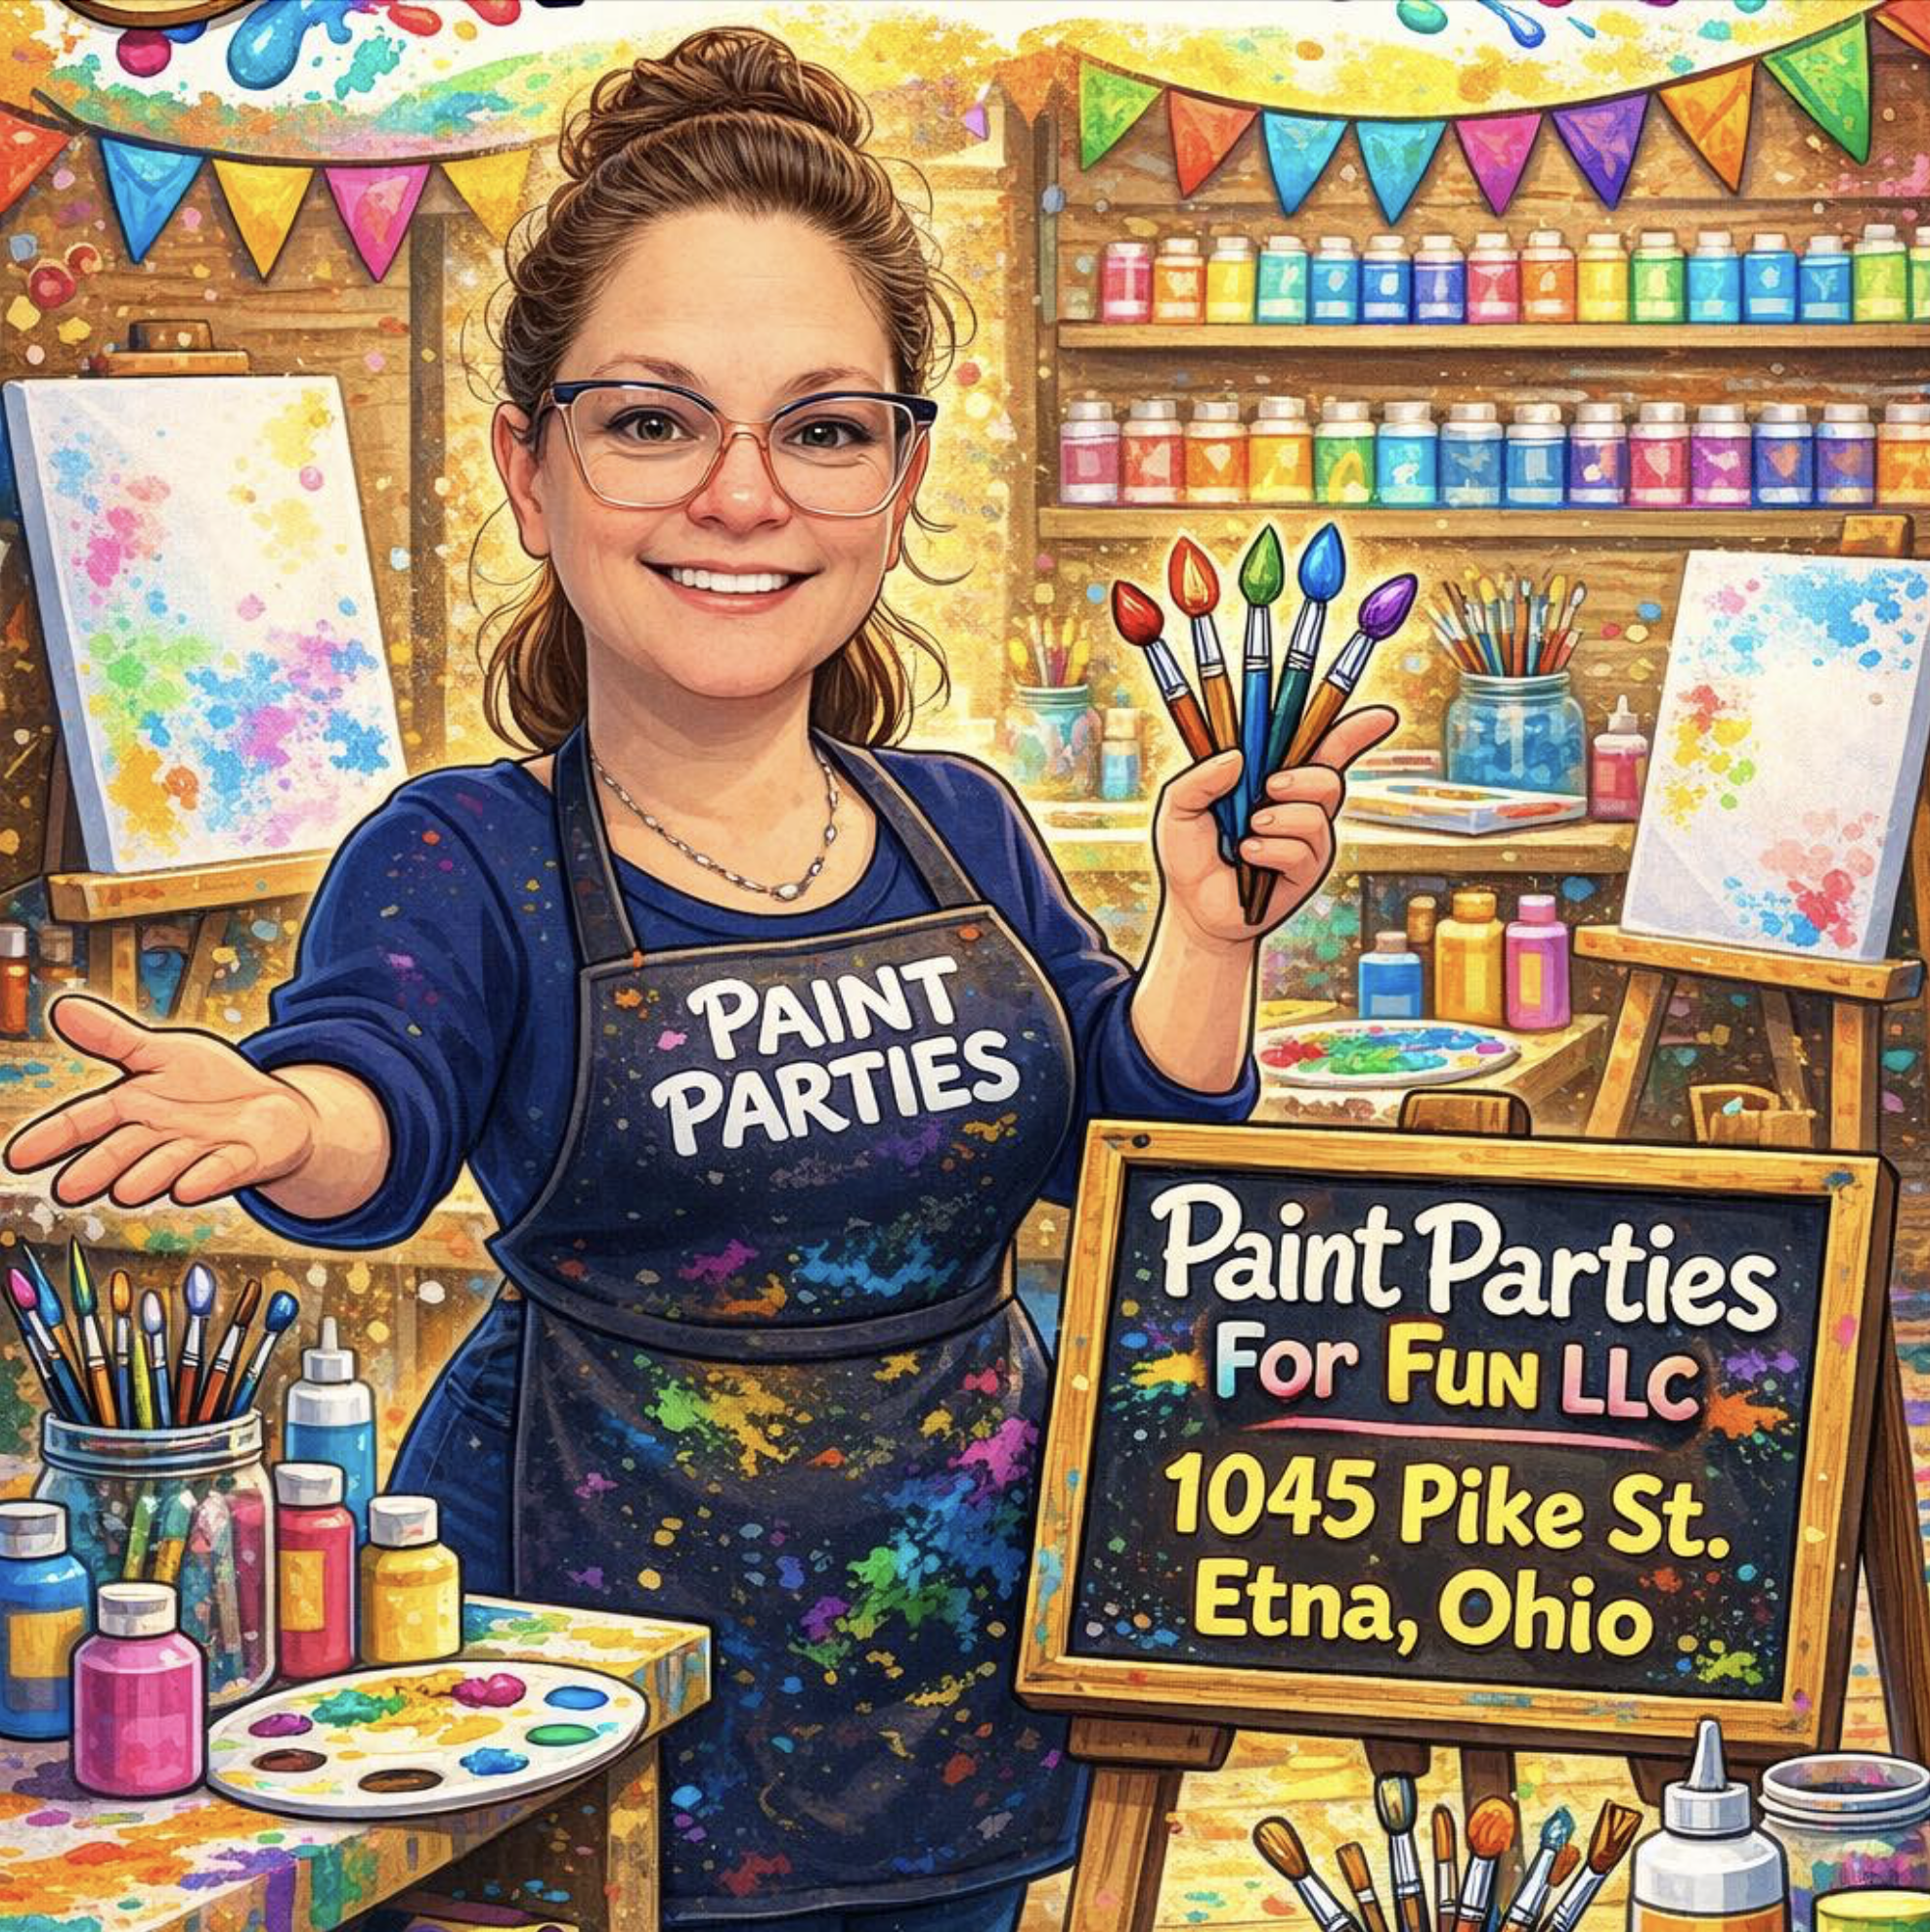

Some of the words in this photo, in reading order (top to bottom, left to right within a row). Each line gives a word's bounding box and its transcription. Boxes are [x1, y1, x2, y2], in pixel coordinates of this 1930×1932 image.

[686, 955, 958, 1060] PAINT
[650, 1030, 1020, 1157] PARTIES
[1150, 1183, 1404, 1311] Paint
[1414, 1201, 1779, 1333] Parties
[1561, 1343, 1700, 1423] LLC
[1164, 1451, 1377, 1540] 1045
[1400, 1463, 1586, 1551] Pike
[1607, 1474, 1732, 1560] St.
[1193, 1558, 1419, 1656] Etna,
[1438, 1568, 1654, 1657] Ohio
